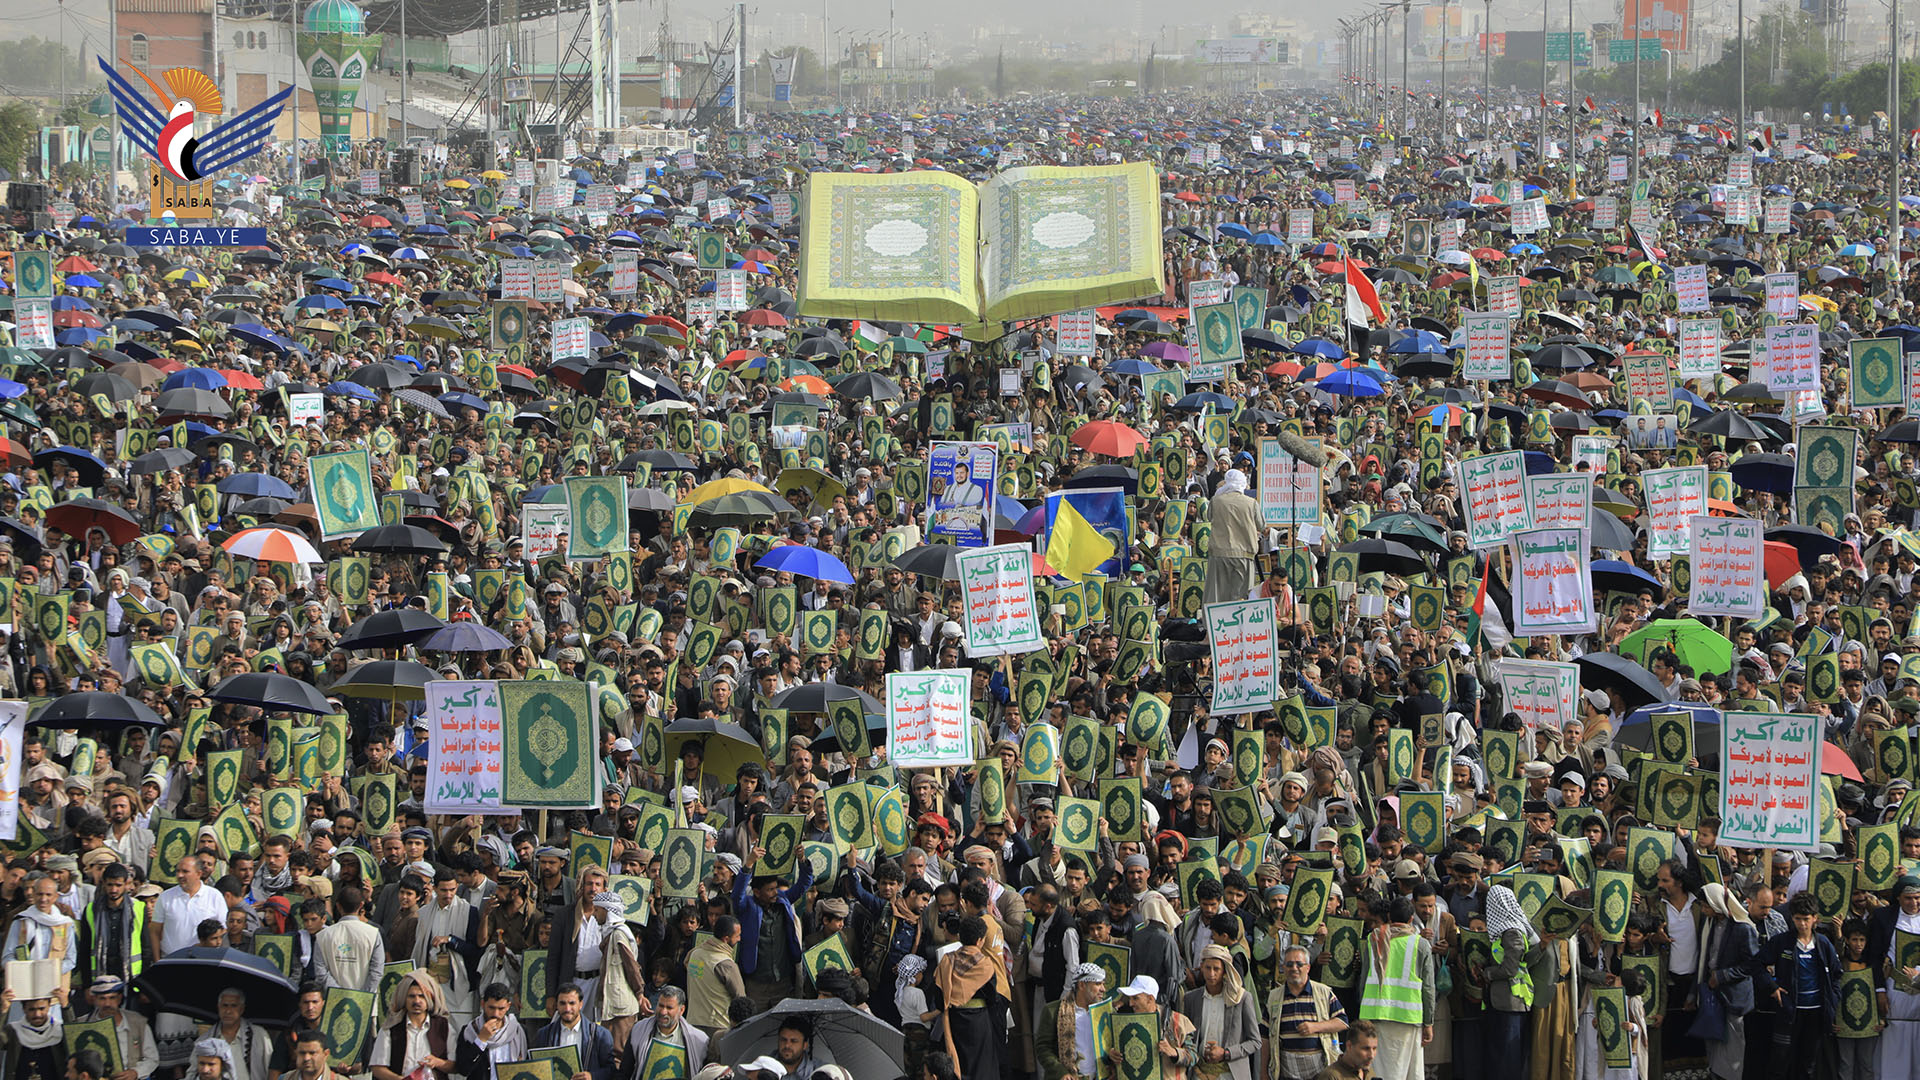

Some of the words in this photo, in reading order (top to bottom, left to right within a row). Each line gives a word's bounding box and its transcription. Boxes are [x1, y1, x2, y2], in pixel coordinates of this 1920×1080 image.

[1265, 464, 1283, 473] DEATH
[1265, 478, 1283, 487] DEATH
[1264, 507, 1289, 519] VICTORY
[1300, 507, 1316, 519] ISLAM
[1700, 521, 1732, 540] أكبر
[1734, 523, 1754, 538] الله
[1521, 536, 1577, 558] قاطعوا
[1730, 544, 1754, 555] الموت
[968, 556, 1000, 580] أكبر
[1004, 557, 1024, 572] الله
[1729, 560, 1754, 571] الموت
[1002, 576, 1027, 590] الموت
[1698, 574, 1718, 586] اليهود
[1720, 576, 1732, 587] على
[1734, 575, 1753, 585] اللعنة
[1548, 582, 1552, 594] و
[1003, 592, 1029, 606] الموت
[1697, 588, 1725, 607] للإسلام
[1728, 587, 1752, 607] النصر
[1011, 607, 1031, 619] اللعنة
[1249, 607, 1269, 623] الله
[1525, 597, 1582, 618] الإسرائيلية
[972, 612, 993, 624] اليهود
[996, 610, 1008, 622] على
[1214, 606, 1246, 633] أكبر
[974, 625, 1003, 643] للإسلام
[1008, 621, 1033, 640] النصر
[1246, 629, 1271, 644] الموت
[1246, 648, 1272, 662] الموت
[1219, 669, 1237, 684] اليهود
[1239, 667, 1249, 681] على
[1253, 665, 1272, 677] اللعنة
[895, 678, 936, 700] أكبر
[938, 680, 961, 695] الله
[1218, 684, 1243, 704] للإسلام
[1246, 680, 1272, 702] النصر
[440, 686, 480, 714] أكبر
[933, 700, 961, 712] الموت
[933, 717, 961, 725] الموت
[896, 731, 920, 744] اليهود
[924, 728, 936, 741] على
[941, 728, 962, 739] اللعنة
[1730, 718, 1779, 746] أكبر
[1781, 722, 1812, 742] الله
[895, 743, 930, 756] للإسلام
[934, 741, 963, 755] النصر
[1730, 746, 1771, 765] لأمريكا
[1775, 751, 1810, 767] الموت
[440, 760, 466, 775] اليهود
[468, 760, 483, 775] على
[1729, 769, 1770, 789] لإسرائيل
[1774, 773, 1809, 790] الموت
[439, 776, 474, 804] للإسلام
[1728, 792, 1758, 809] اليهود
[1761, 794, 1777, 811] على
[1781, 794, 1808, 809] اللعنة
[1726, 811, 1768, 840] للإسلام
[1771, 814, 1808, 842] النصر
